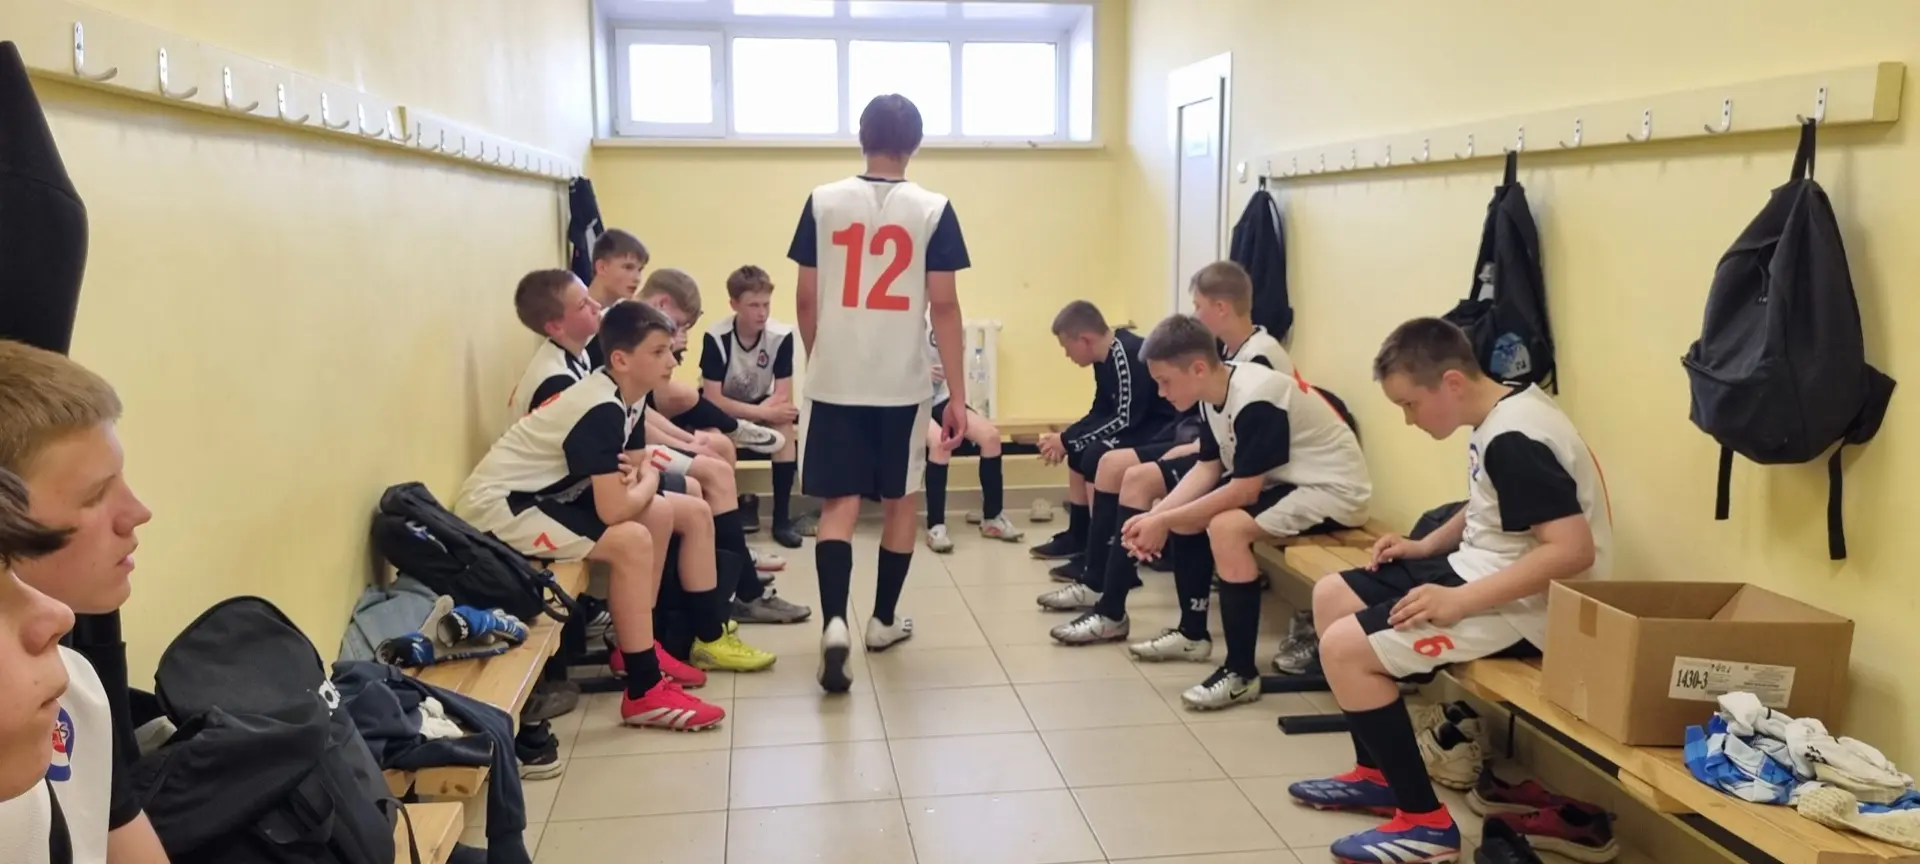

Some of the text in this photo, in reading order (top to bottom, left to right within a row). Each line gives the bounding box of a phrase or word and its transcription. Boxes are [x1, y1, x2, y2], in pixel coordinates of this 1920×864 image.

[832, 222, 913, 311] 12
[533, 531, 557, 550] 7
[1676, 669, 1709, 690] 1430-3
